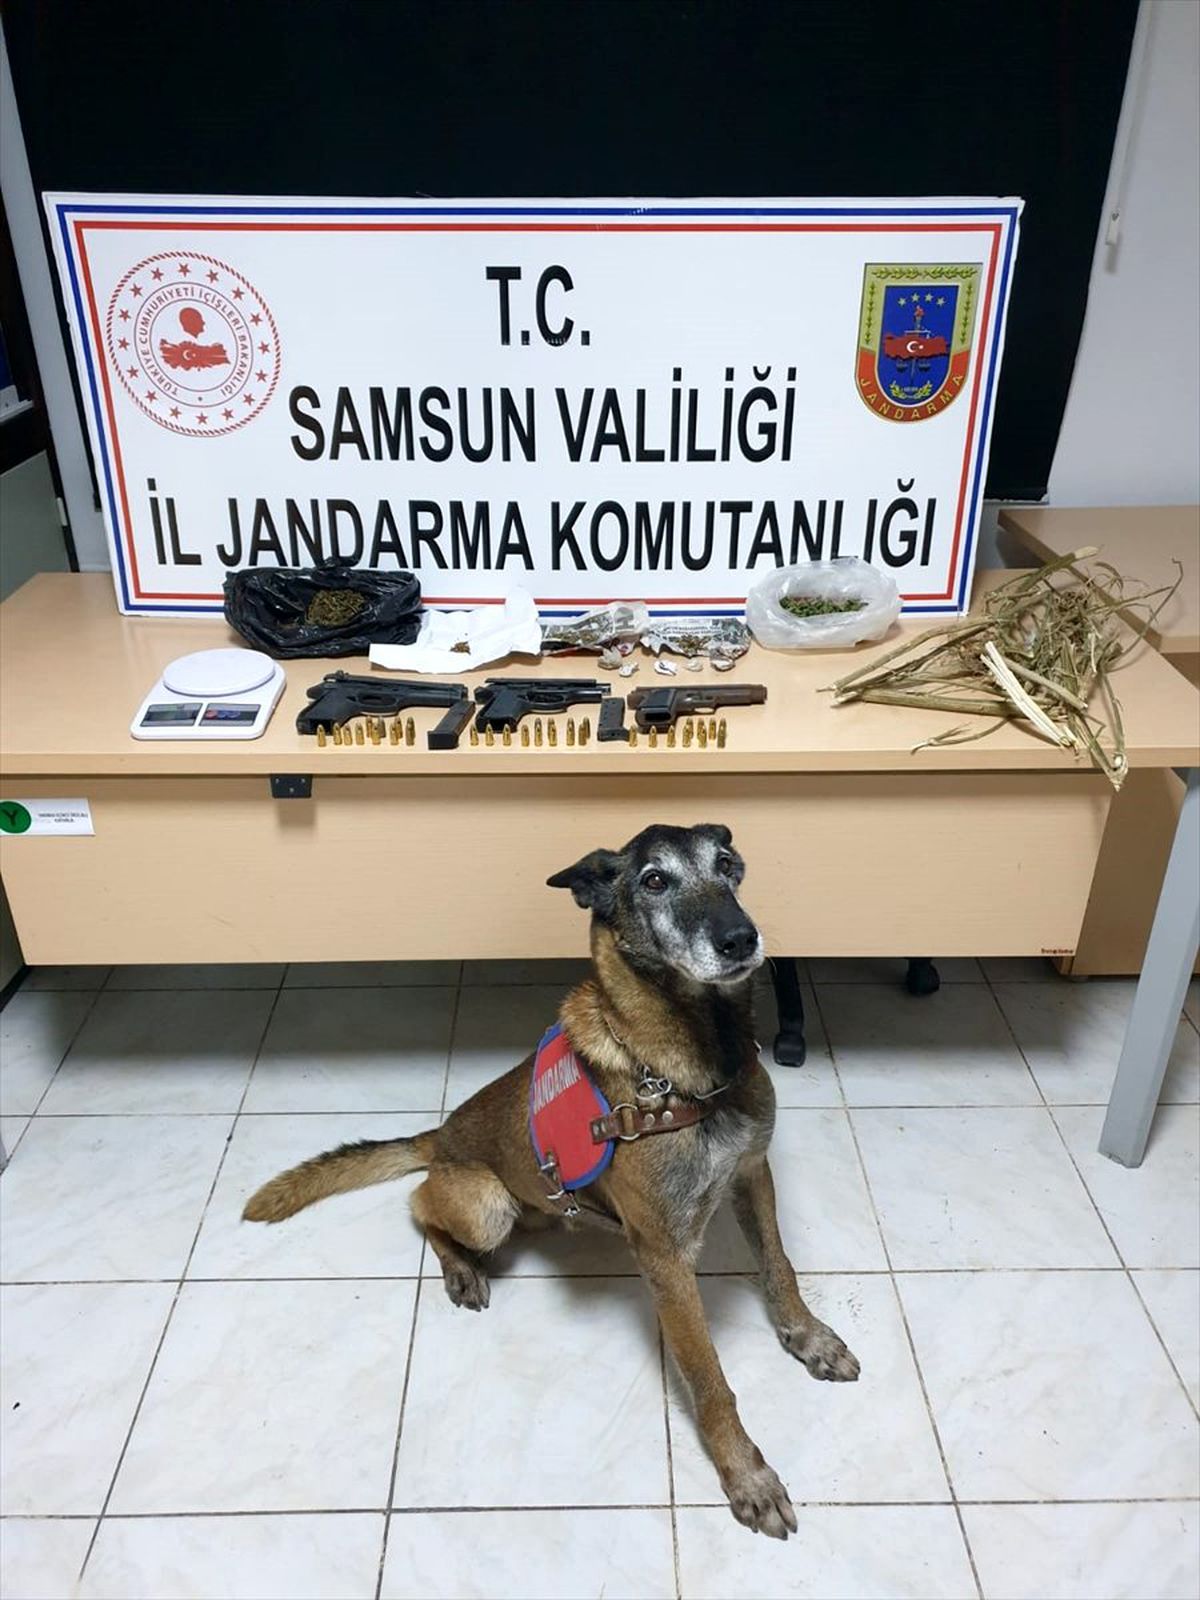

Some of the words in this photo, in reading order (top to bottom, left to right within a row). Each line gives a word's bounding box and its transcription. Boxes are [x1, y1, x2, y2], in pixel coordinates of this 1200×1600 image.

[138, 286, 195, 343] CUMHURİYETİ
[199, 288, 243, 334] İÇİŞLERİ
[486, 265, 591, 347] T.C.
[139, 349, 178, 396] TÜRKİYE
[220, 335, 250, 398] BAKANLIĞI
[289, 385, 536, 463] SAMSUN
[556, 366, 796, 463] VALİLİĞİ
[860, 374, 965, 420] JANDARMA
[147, 478, 202, 566] İL
[216, 497, 535, 570] JANDARMA
[550, 478, 937, 571] KOMUTANLIĞI
[2, 810, 18, 827] Y
